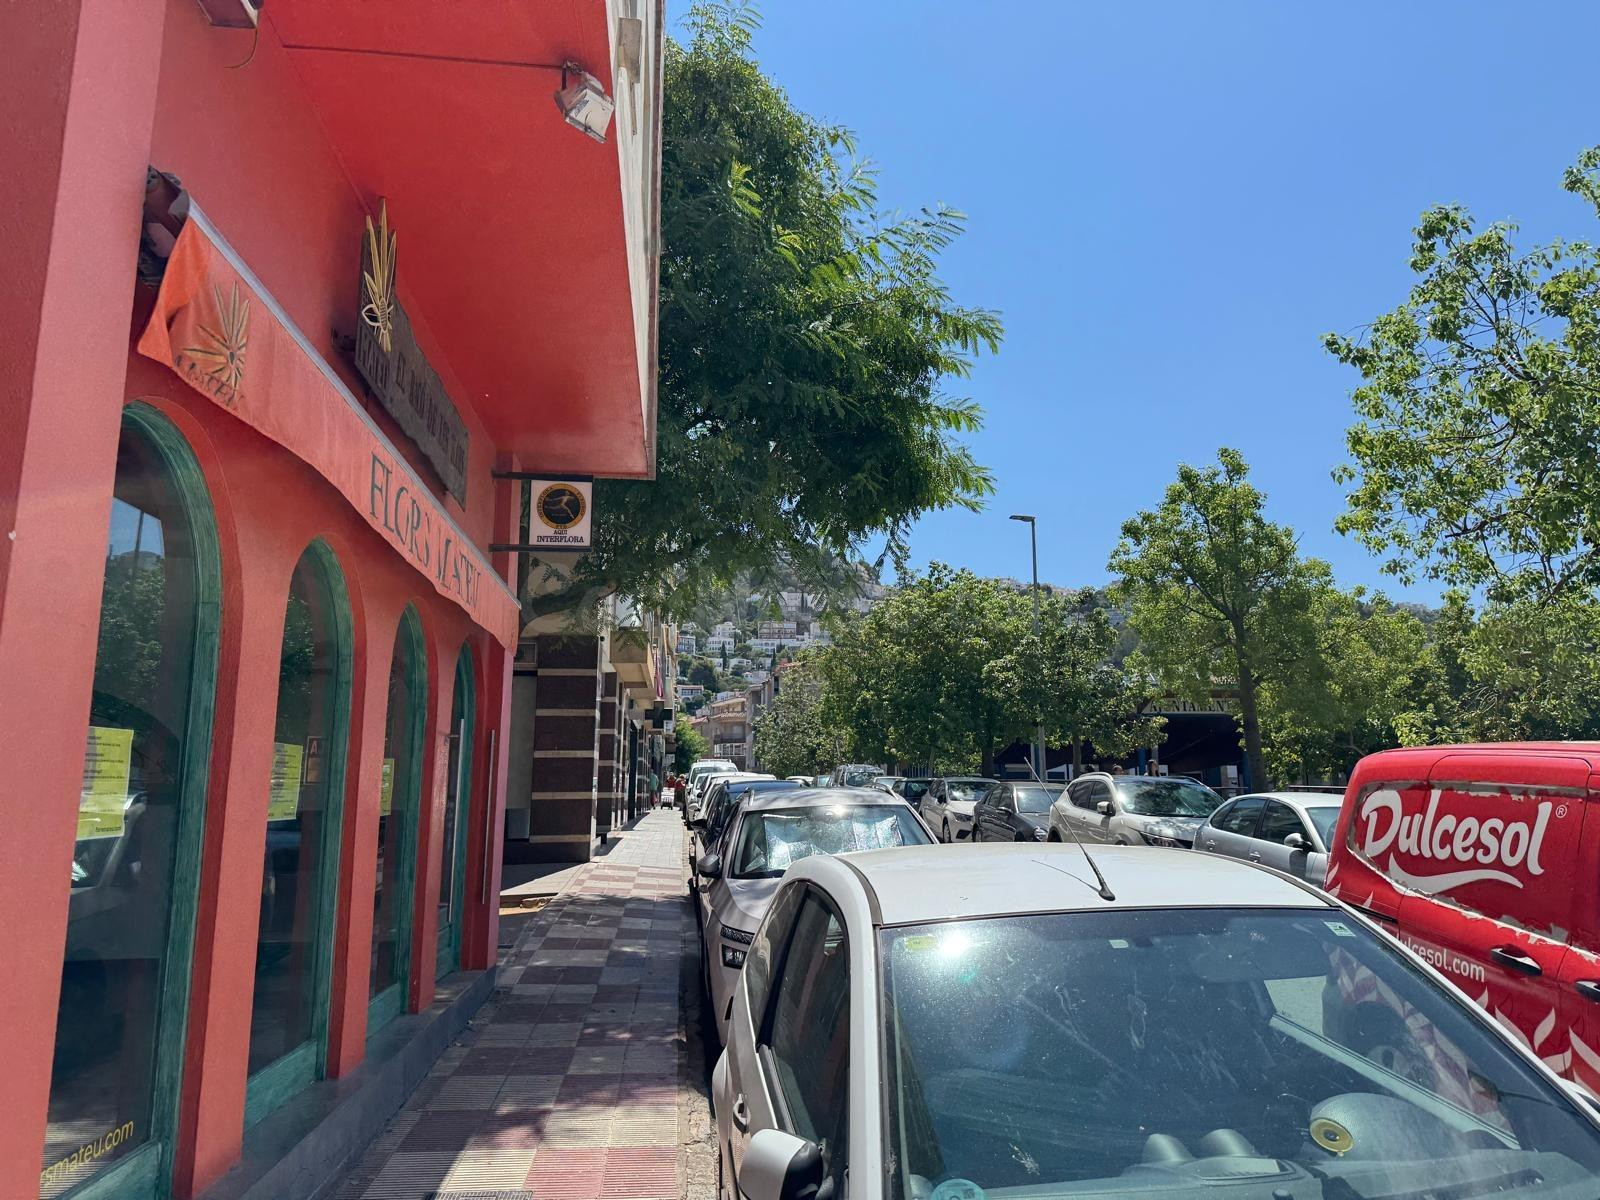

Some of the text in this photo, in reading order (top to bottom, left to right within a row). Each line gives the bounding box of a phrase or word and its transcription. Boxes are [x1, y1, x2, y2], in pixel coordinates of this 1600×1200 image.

[369, 452, 430, 567] FLORS
[436, 527, 482, 614] MATEU
[536, 535, 584, 543] INTERFLORA
[1362, 788, 1552, 876] Dulcesol
